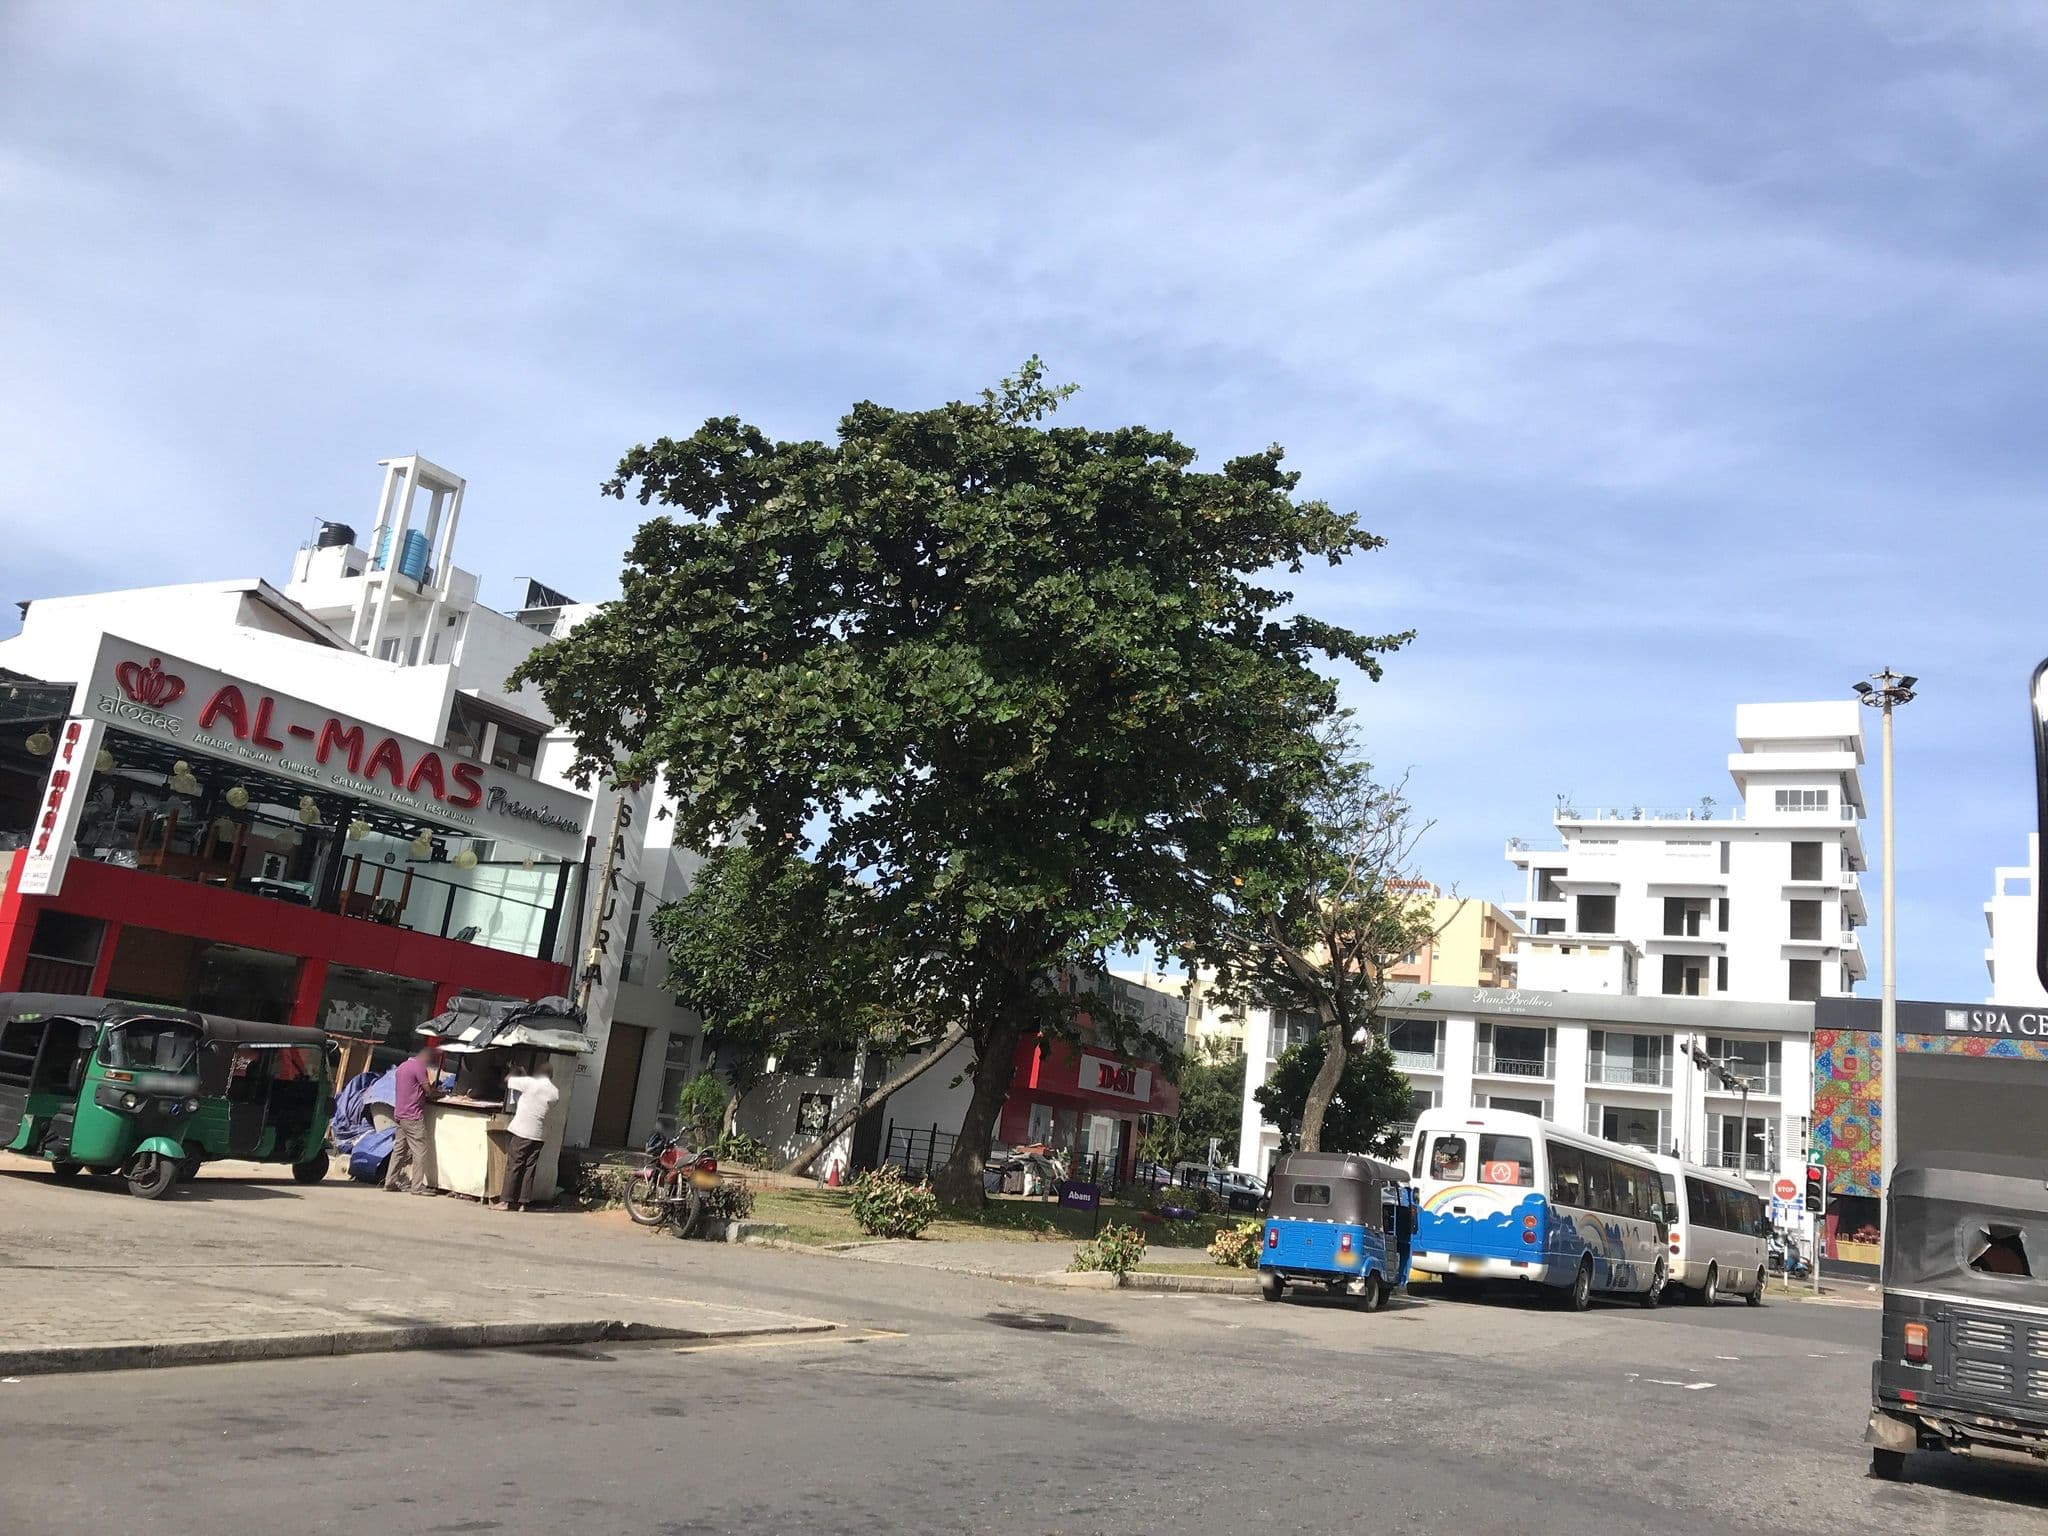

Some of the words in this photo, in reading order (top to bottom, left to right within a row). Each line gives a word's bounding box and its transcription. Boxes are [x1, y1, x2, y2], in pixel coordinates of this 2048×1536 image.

[199, 684, 485, 808] AL-MAAS
[487, 786, 582, 835] Premium
[193, 733, 233, 752] ARABIC
[238, 746, 273, 763] INDIAN
[279, 758, 321, 778] CHINESE
[390, 793, 419, 810] FAMILY
[1504, 989, 1553, 1007] Brothers
[1972, 1011, 2013, 1034] SPA
[1097, 1063, 1137, 1095] DSI
[1067, 1190, 1091, 1201] Abans
[1777, 1186, 1795, 1194] STOP
